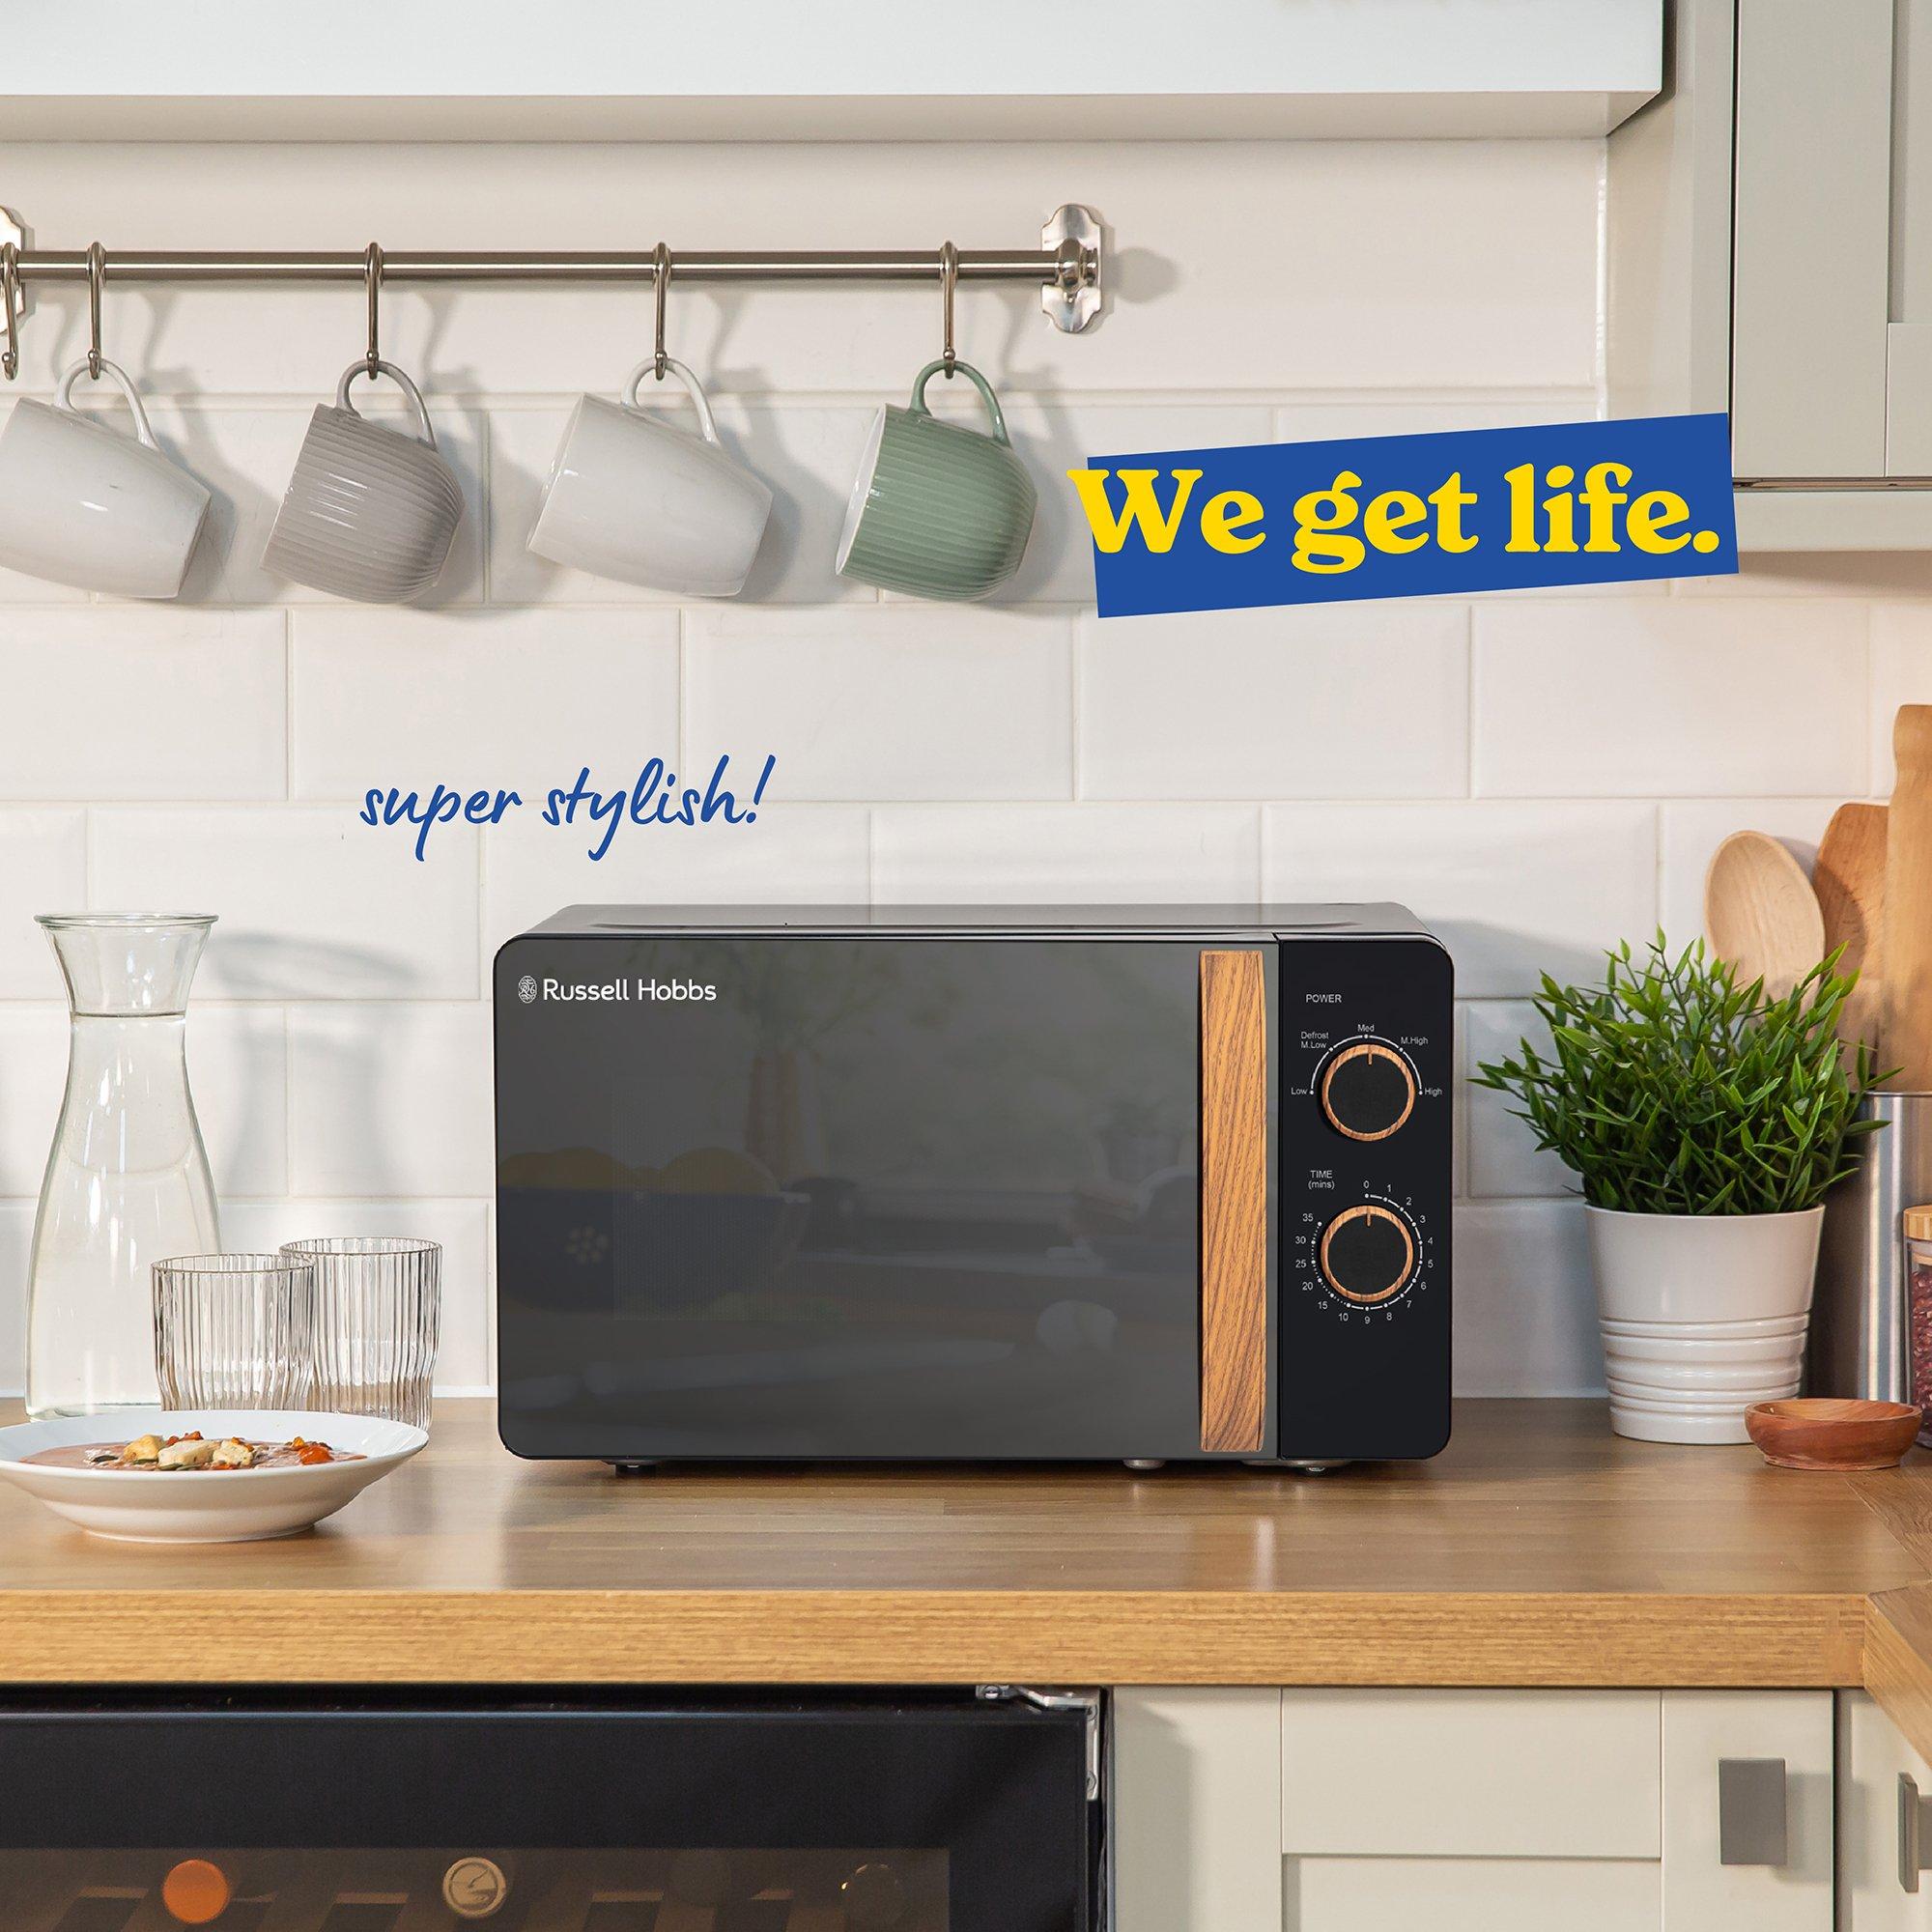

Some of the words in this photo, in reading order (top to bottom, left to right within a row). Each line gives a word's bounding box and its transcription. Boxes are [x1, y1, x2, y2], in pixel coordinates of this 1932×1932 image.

[542, 978, 630, 1002] Russell
[638, 978, 718, 1002] Hobbs
[1305, 993, 1343, 1004] POWER
[1356, 1023, 1376, 1033] Med
[1300, 1031, 1329, 1039] Defrost
[1300, 1040, 1327, 1049] M.Low
[1400, 1036, 1429, 1046] M.High
[1291, 1087, 1308, 1095] Low
[1424, 1087, 1443, 1097] High
[1309, 1169, 1333, 1179] TIME
[1307, 1179, 1335, 1190] (mins)
[1362, 1179, 1370, 1189] 0
[1386, 1183, 1392, 1193] 1
[1406, 1196, 1412, 1207] 2
[1302, 1212, 1314, 1223] 35
[1419, 1214, 1427, 1224] 3
[1294, 1236, 1307, 1245] 30
[1427, 1236, 1434, 1245] 4
[1294, 1259, 1307, 1268] 25
[1427, 1259, 1435, 1269] 5
[1301, 1281, 1314, 1292] 20
[1420, 1281, 1427, 1291] 6
[1317, 1300, 1328, 1310] 15
[1406, 1299, 1412, 1309] 7
[1338, 1312, 1350, 1322] 10
[1364, 1315, 1371, 1325] 9
[1385, 1311, 1393, 1321] 8
